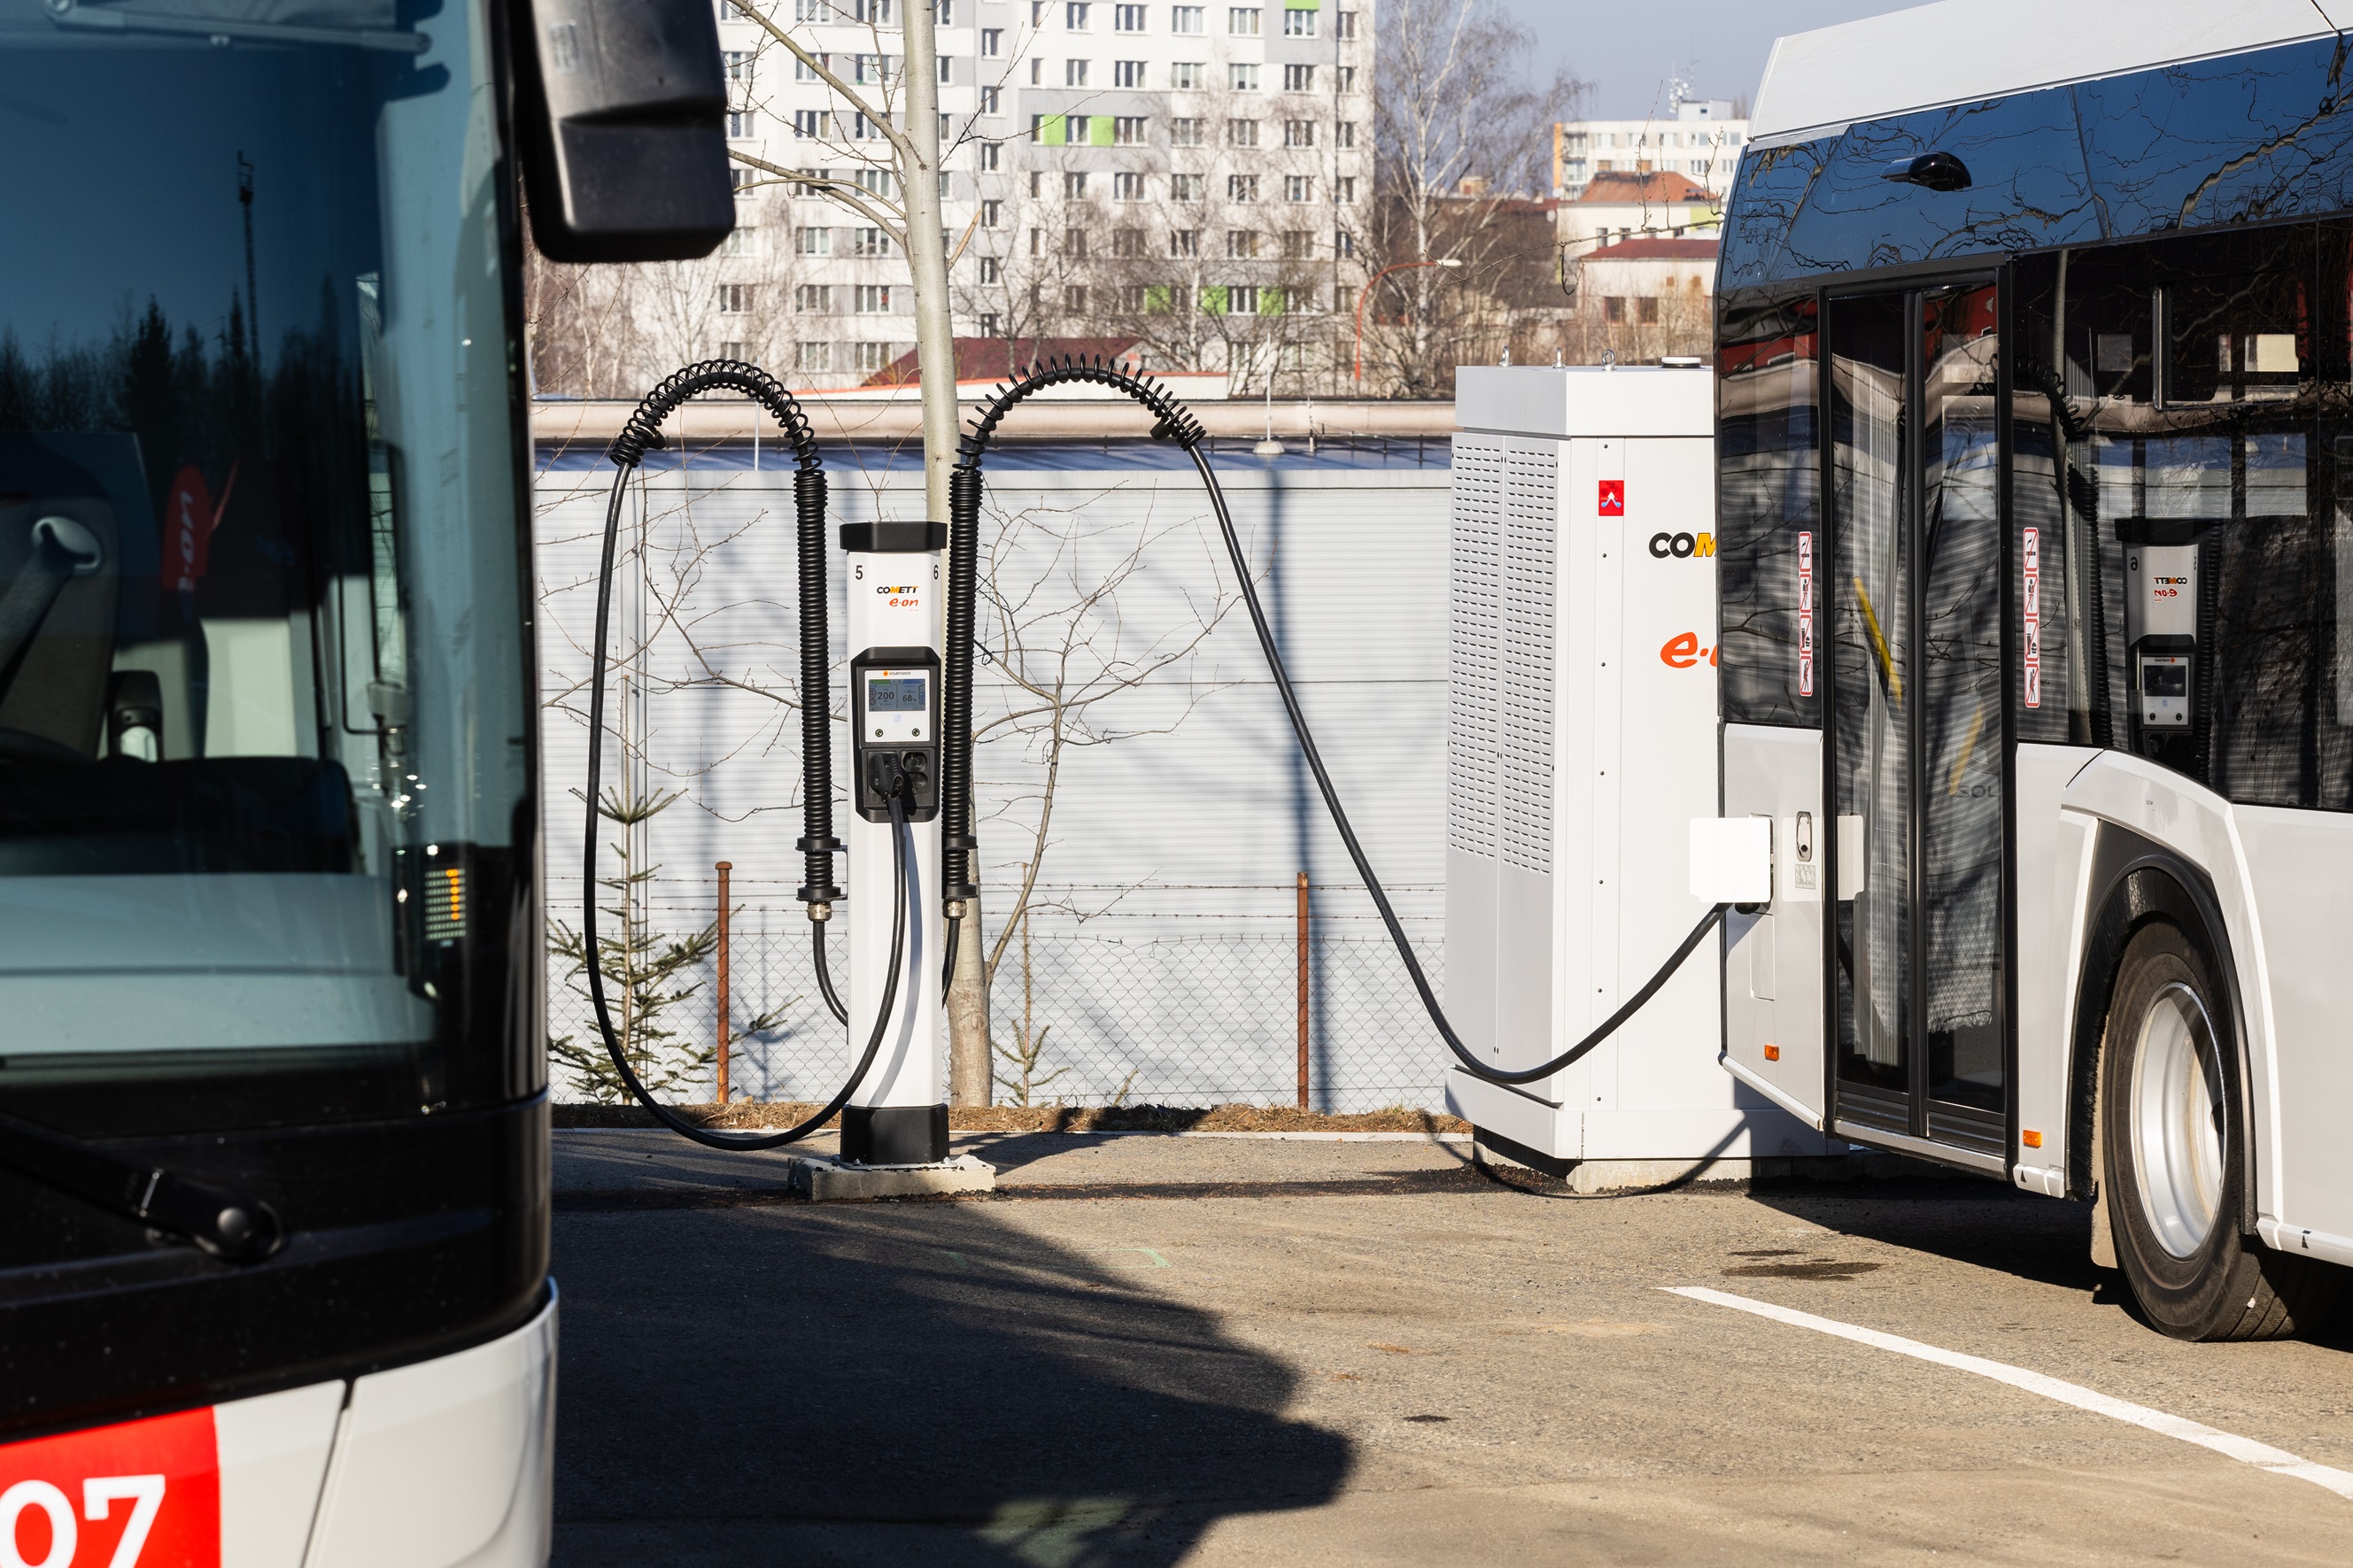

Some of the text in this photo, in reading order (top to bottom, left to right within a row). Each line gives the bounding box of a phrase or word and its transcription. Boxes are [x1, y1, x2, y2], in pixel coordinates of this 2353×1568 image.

[1649, 532, 1715, 558] COM
[855, 565, 863, 580] 5
[933, 564, 939, 580] 6
[0, 1473, 166, 1568] 07
